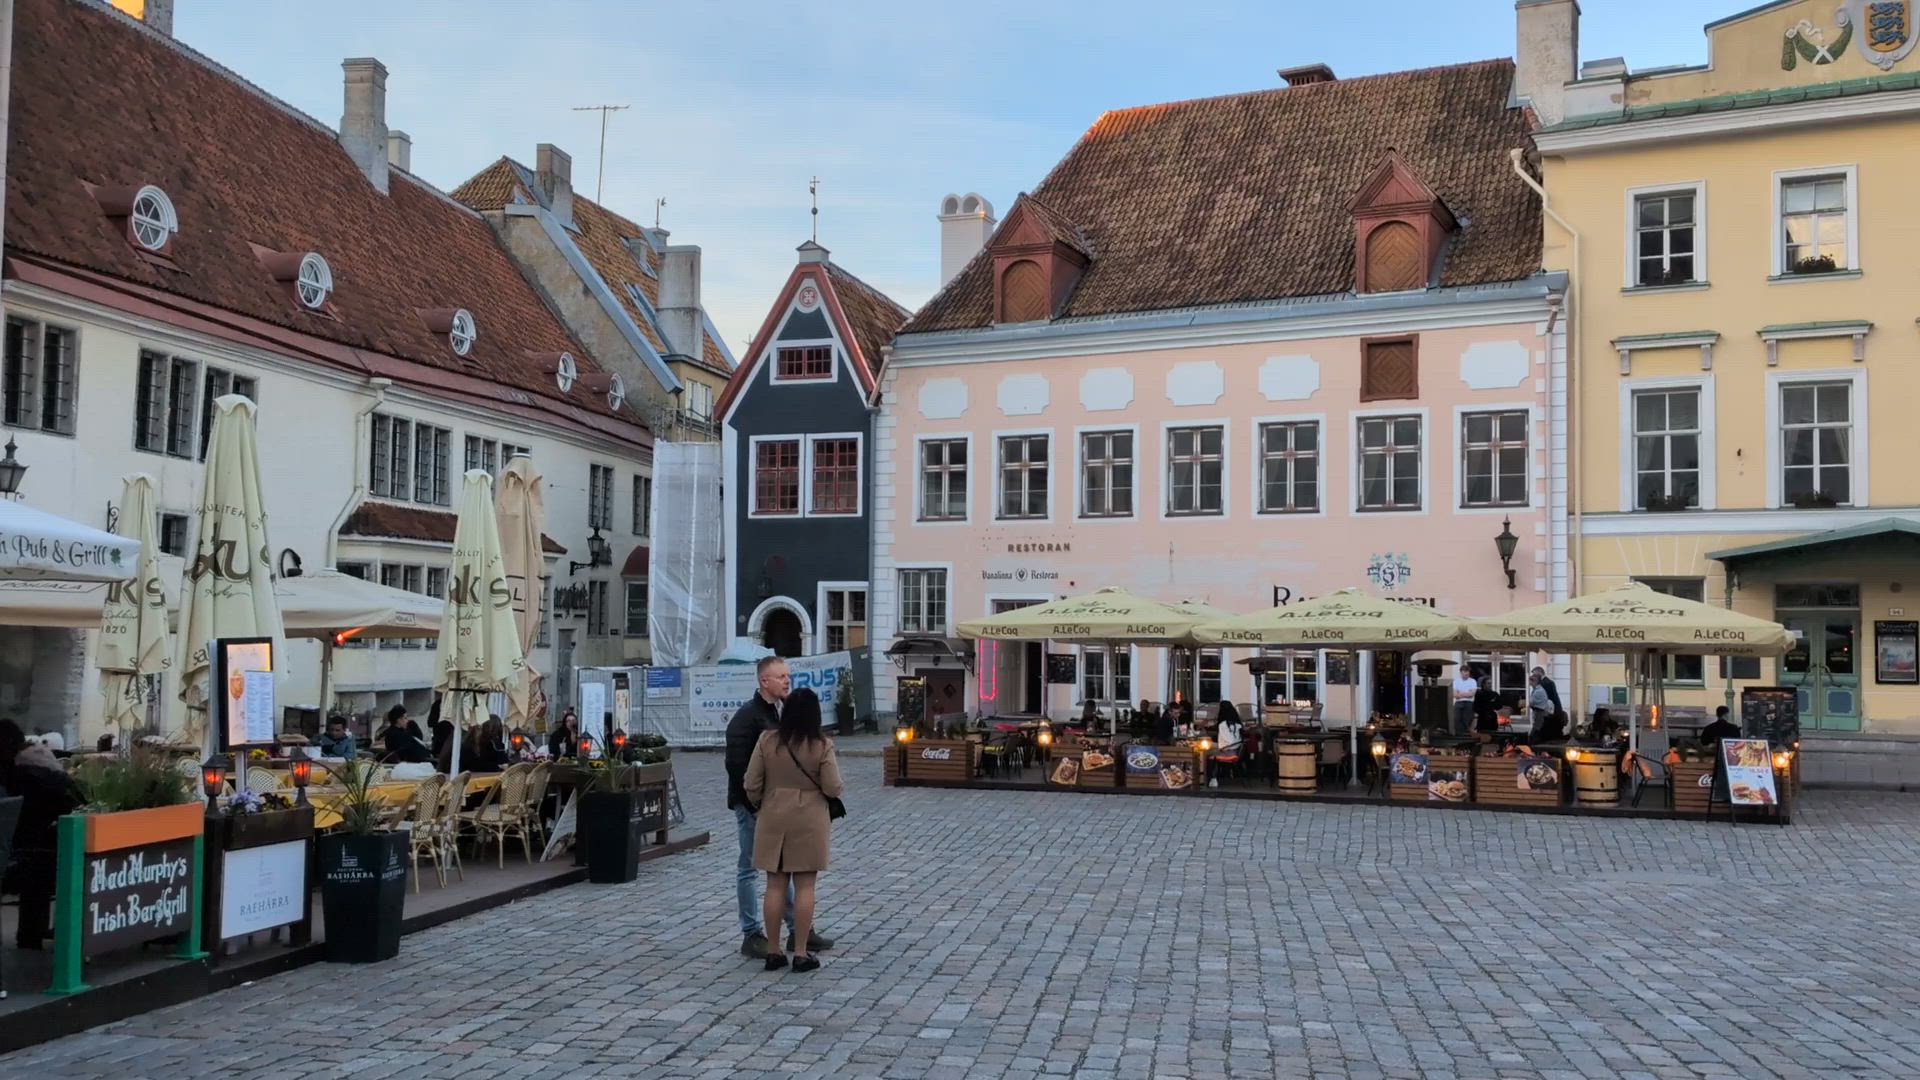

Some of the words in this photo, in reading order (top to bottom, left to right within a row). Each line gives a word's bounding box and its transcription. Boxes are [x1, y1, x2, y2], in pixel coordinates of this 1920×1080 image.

[12, 535, 48, 566] Pub
[52, 539, 66, 564] &
[68, 541, 108, 567] Grill
[1007, 542, 1071, 553] RESTORAN
[1031, 570, 1059, 580] Restoran
[101, 625, 127, 634] 1820
[90, 858, 128, 894] Mad
[128, 851, 188, 885] Murphy's
[90, 902, 127, 935] Irish
[127, 893, 155, 926] Bar
[163, 886, 188, 927] Grill
